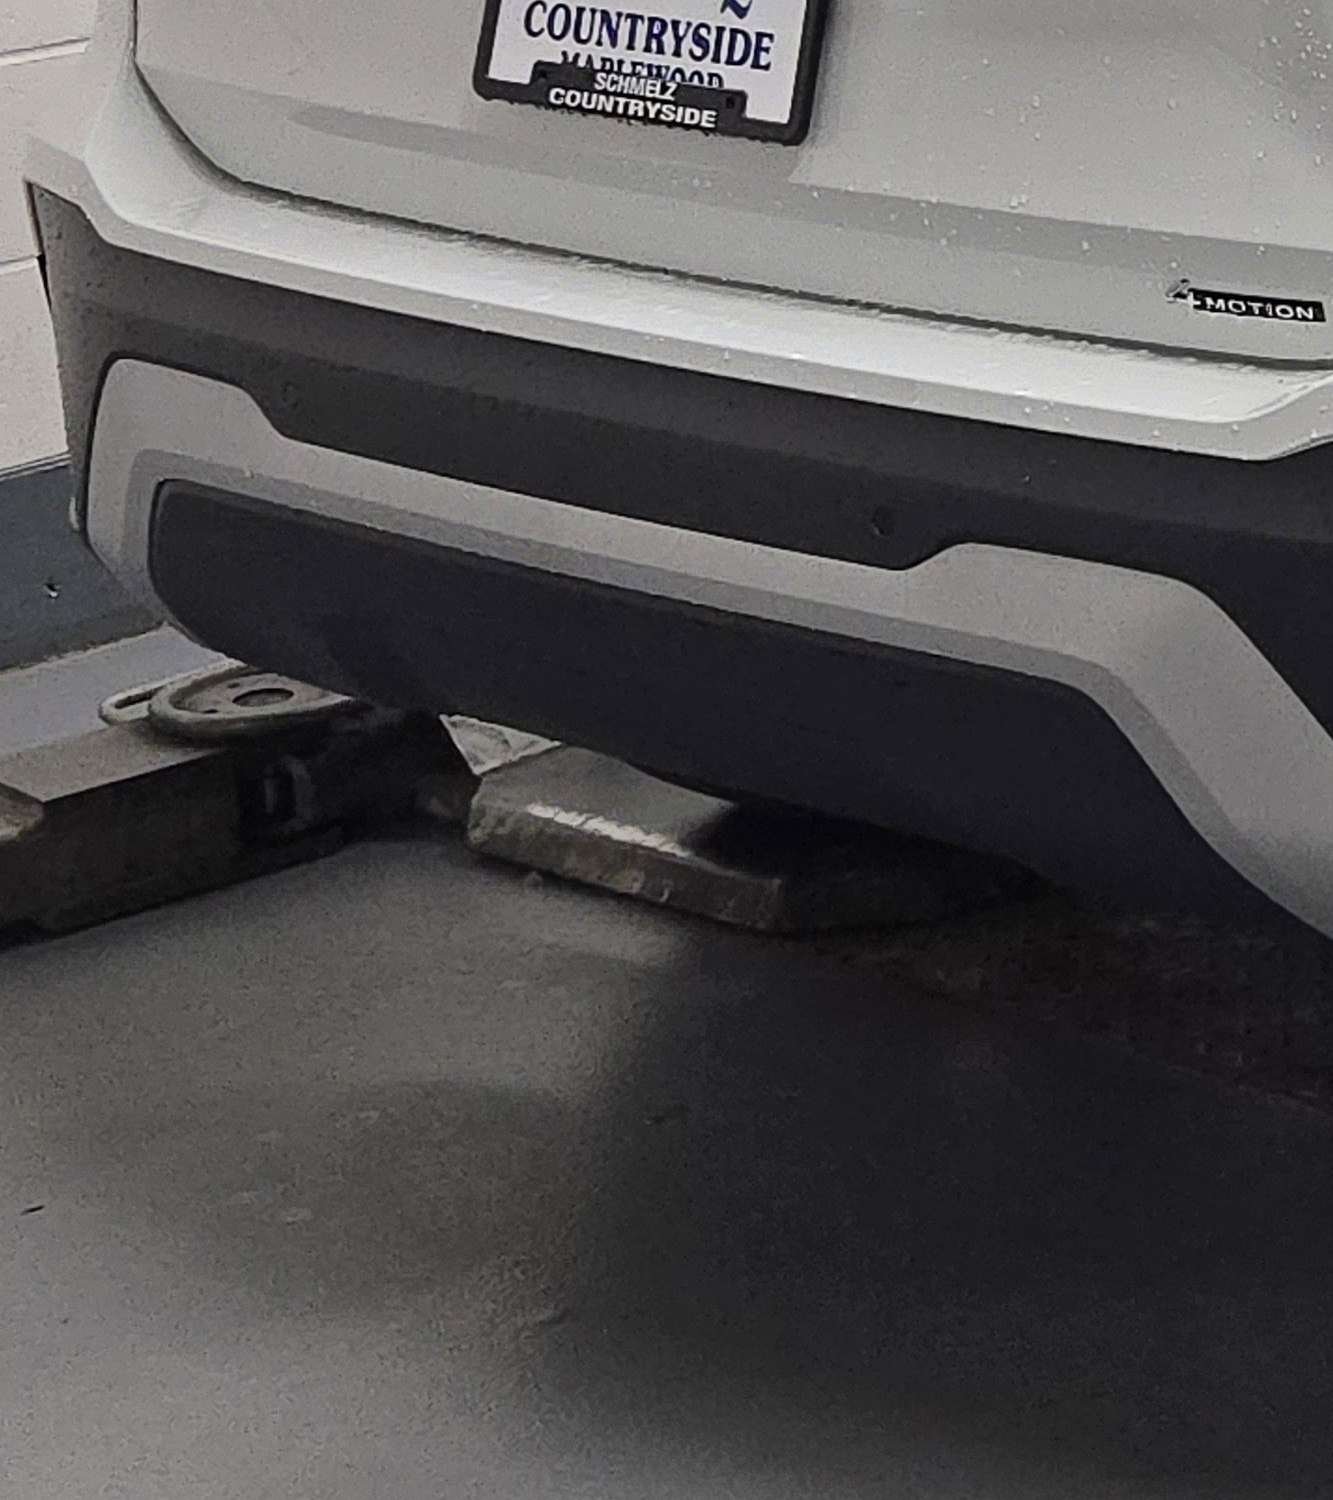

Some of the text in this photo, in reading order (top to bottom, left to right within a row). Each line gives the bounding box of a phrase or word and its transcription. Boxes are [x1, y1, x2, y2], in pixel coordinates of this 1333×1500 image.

[524, 0, 775, 72] COUNTRYSIDE
[594, 72, 679, 102] SCHMELZ
[549, 87, 718, 130] COUNTRYSIDE
[1165, 278, 1315, 320] 4MOTION
